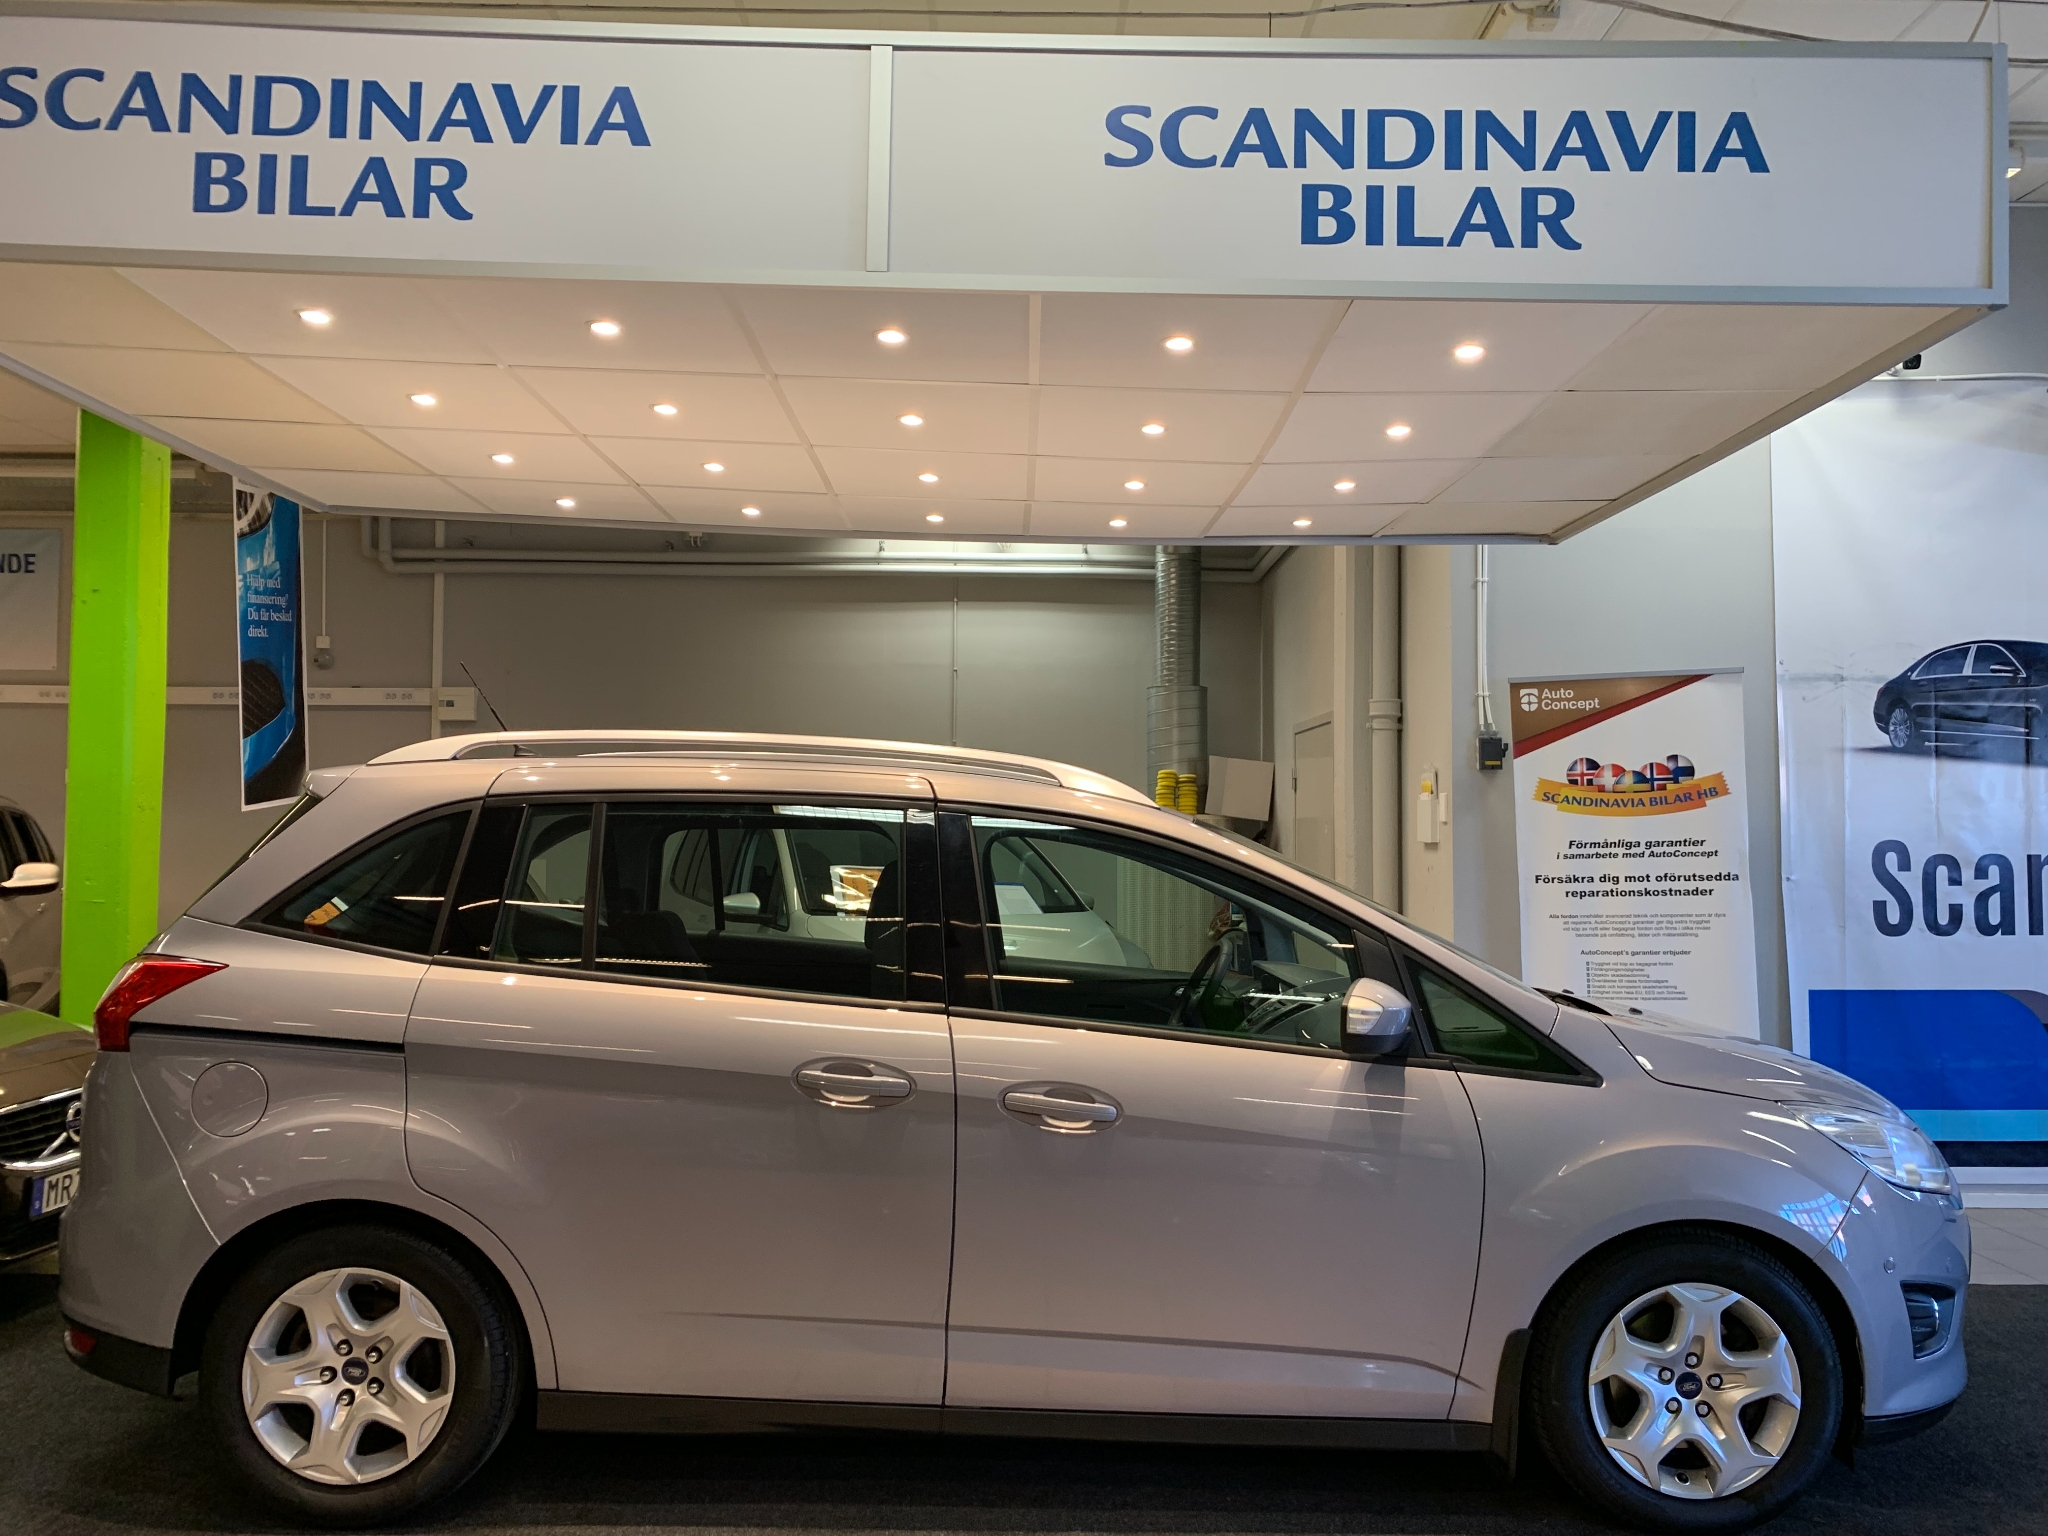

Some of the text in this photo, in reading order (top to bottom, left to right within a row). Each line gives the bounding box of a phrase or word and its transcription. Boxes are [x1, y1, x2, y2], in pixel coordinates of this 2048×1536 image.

[0, 66, 652, 148] SCANDINAVIA
[1103, 103, 1771, 174] SCANDINAVIA
[192, 151, 474, 221] BILAR
[1300, 183, 1583, 251] BILAR
[0, 553, 36, 574] DE
[267, 577, 281, 588] med
[248, 607, 259, 620] Du
[270, 609, 292, 621] besked
[1541, 688, 1574, 699] Auto
[1541, 697, 1600, 711] Concept
[1541, 788, 1719, 808] SCANDINAVIA BILAR HB
[1568, 838, 1706, 851] Förmånliga garantier
[1556, 849, 1719, 860] i samarbete med AutoConcept
[1534, 871, 1740, 885] Försäkra dig mot oförutsedda
[1565, 887, 1715, 900] reparationskostnader
[46, 1171, 80, 1209] MR
